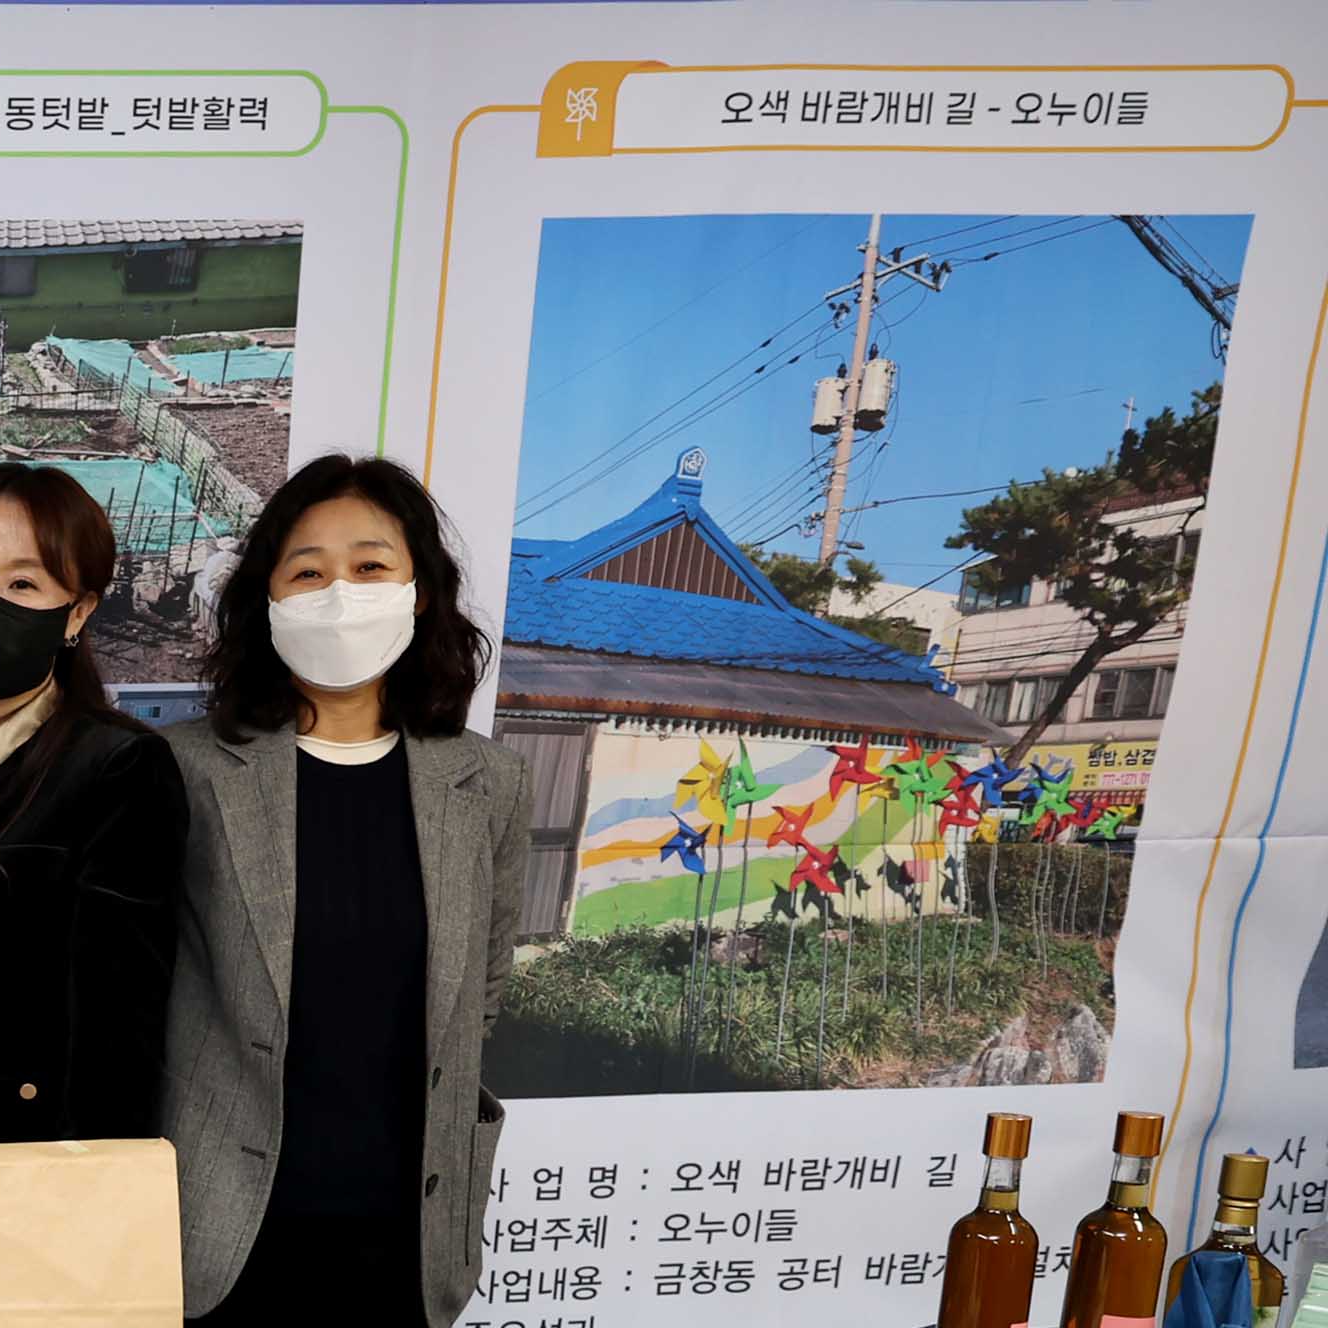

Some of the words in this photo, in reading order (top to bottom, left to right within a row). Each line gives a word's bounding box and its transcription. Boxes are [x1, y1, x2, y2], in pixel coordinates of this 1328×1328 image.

[721, 90, 790, 124] 오색
[801, 90, 934, 125] 바람개비
[946, 92, 977, 125] 길
[1011, 92, 1148, 126] 오누이들
[533, 1166, 563, 1201] 업
[588, 1164, 618, 1199] 명
[671, 1159, 741, 1193] 오색
[764, 1155, 901, 1192] 바람개비
[927, 1153, 957, 1188] 길
[658, 1208, 799, 1244] 오누이들
[1262, 1227, 1310, 1262] 사
[654, 1260, 755, 1296] 금창동
[777, 1255, 842, 1291] 공터
